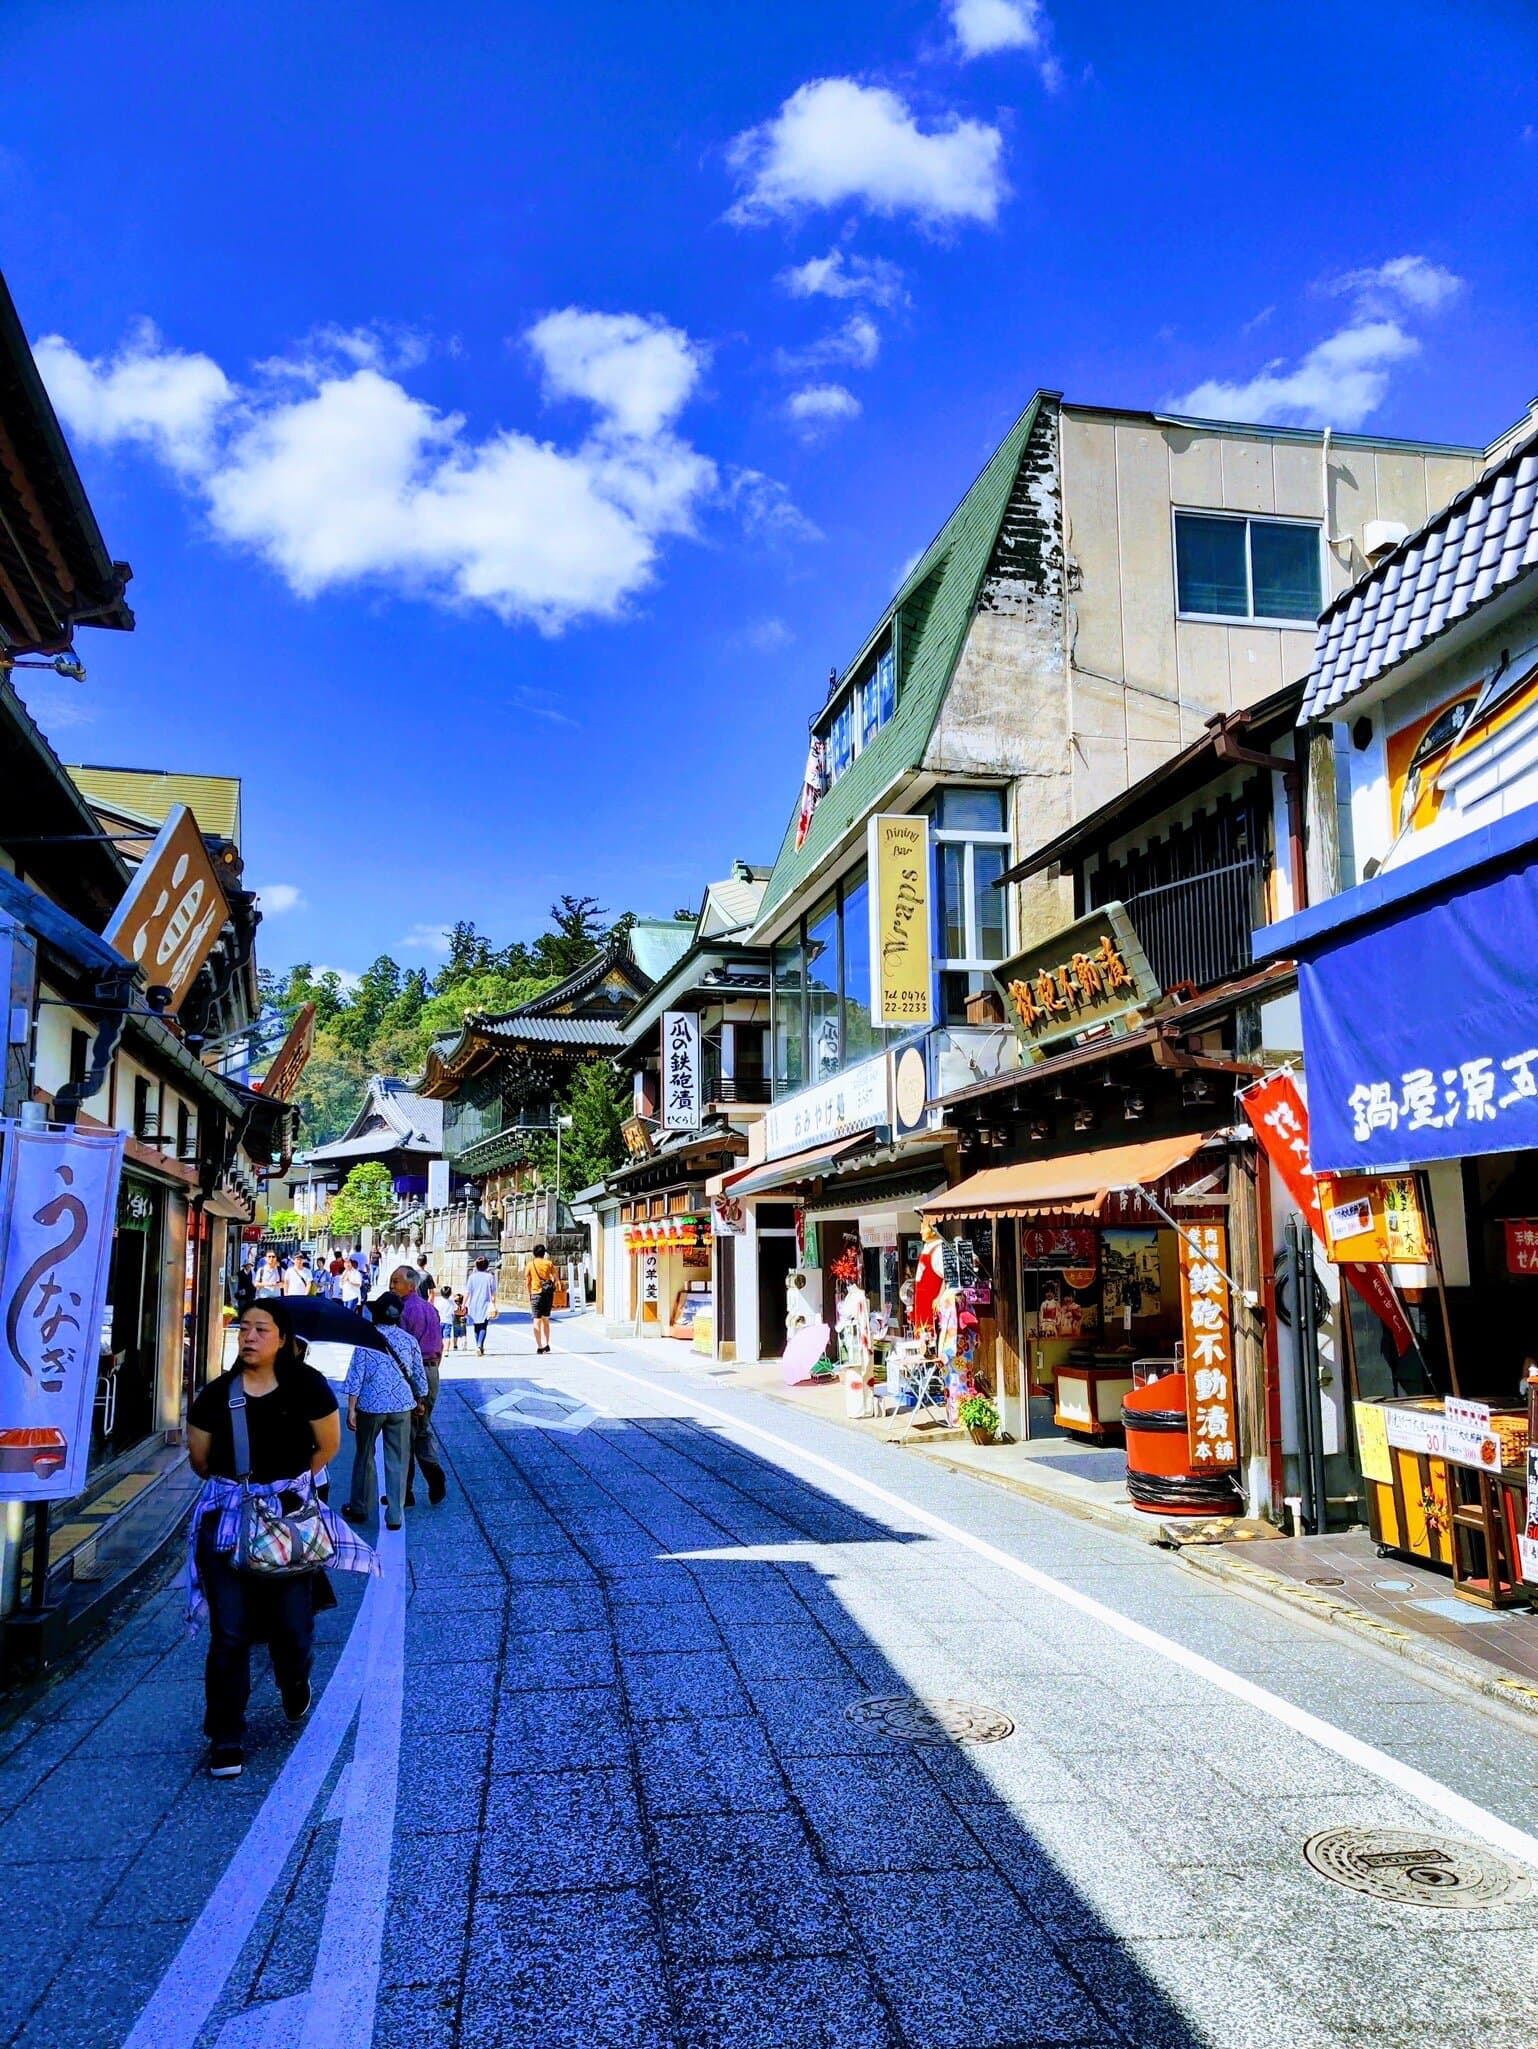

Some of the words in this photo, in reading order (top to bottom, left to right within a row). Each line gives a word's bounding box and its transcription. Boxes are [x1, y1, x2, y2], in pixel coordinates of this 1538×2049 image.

[886, 827, 920, 843] Dining
[892, 845, 913, 857] Bar
[883, 869, 925, 977] Wraps
[885, 990, 898, 1000] Tel
[901, 991, 926, 1001] 0476
[885, 1002, 927, 1013] 22-2233
[669, 1016, 694, 1110] 瓜の鉄砲漬
[6, 1165, 88, 1393] うなぎ
[1188, 1263, 1228, 1439] 鉄砲不動漬
